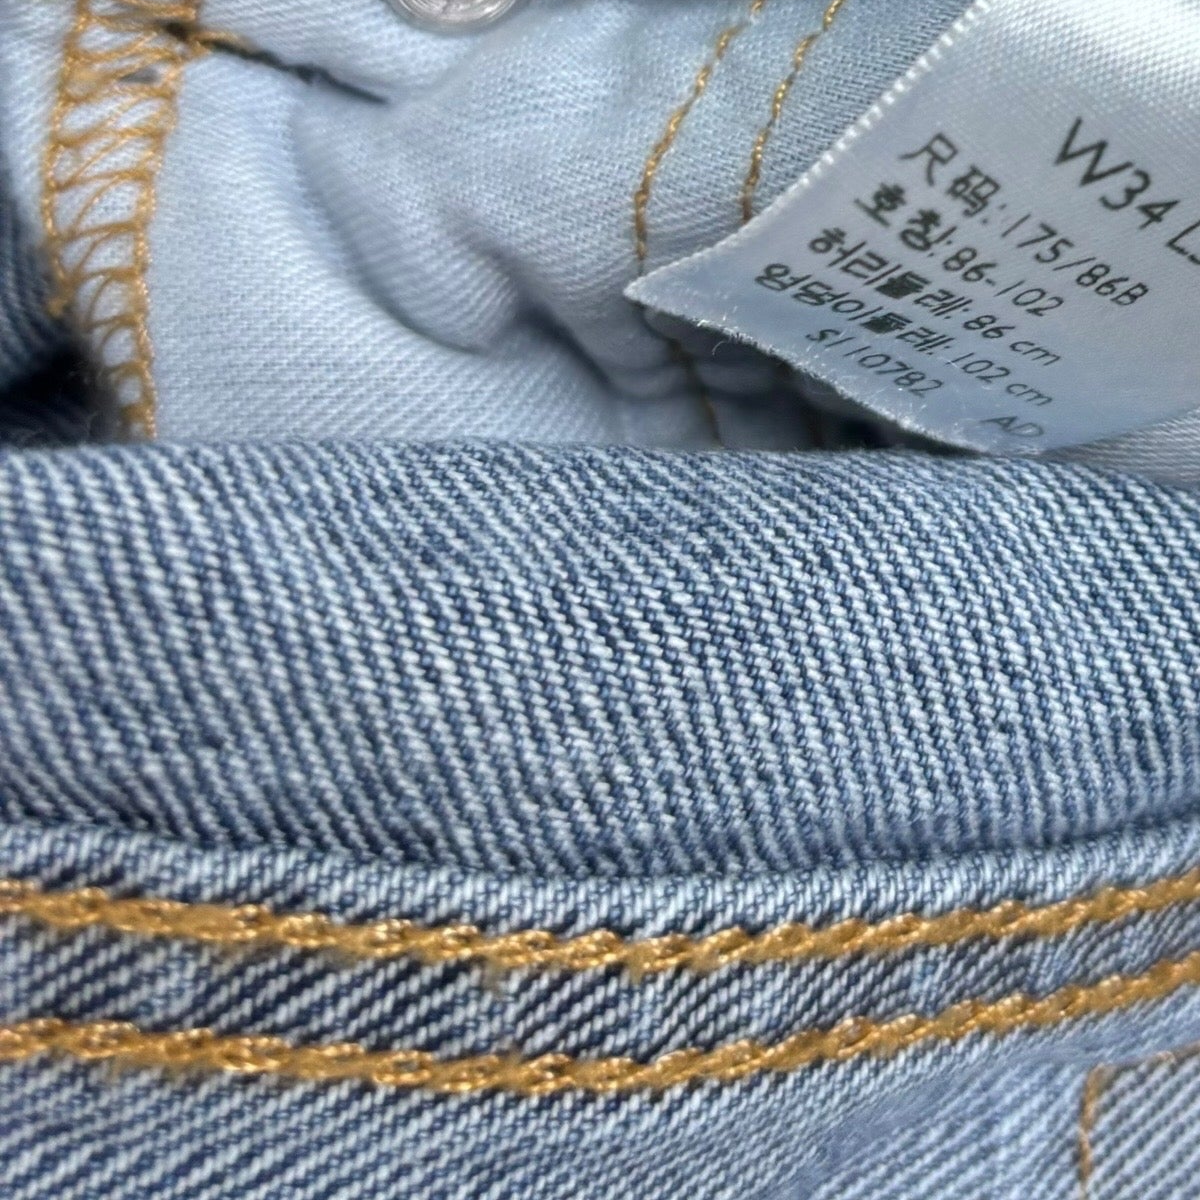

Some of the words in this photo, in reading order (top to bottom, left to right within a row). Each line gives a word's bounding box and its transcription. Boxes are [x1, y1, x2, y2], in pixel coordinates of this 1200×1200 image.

[1054, 117, 1180, 229] W34
[805, 328, 944, 398] S110782
[1009, 340, 1061, 366] cm
[1005, 383, 1052, 406] cm
